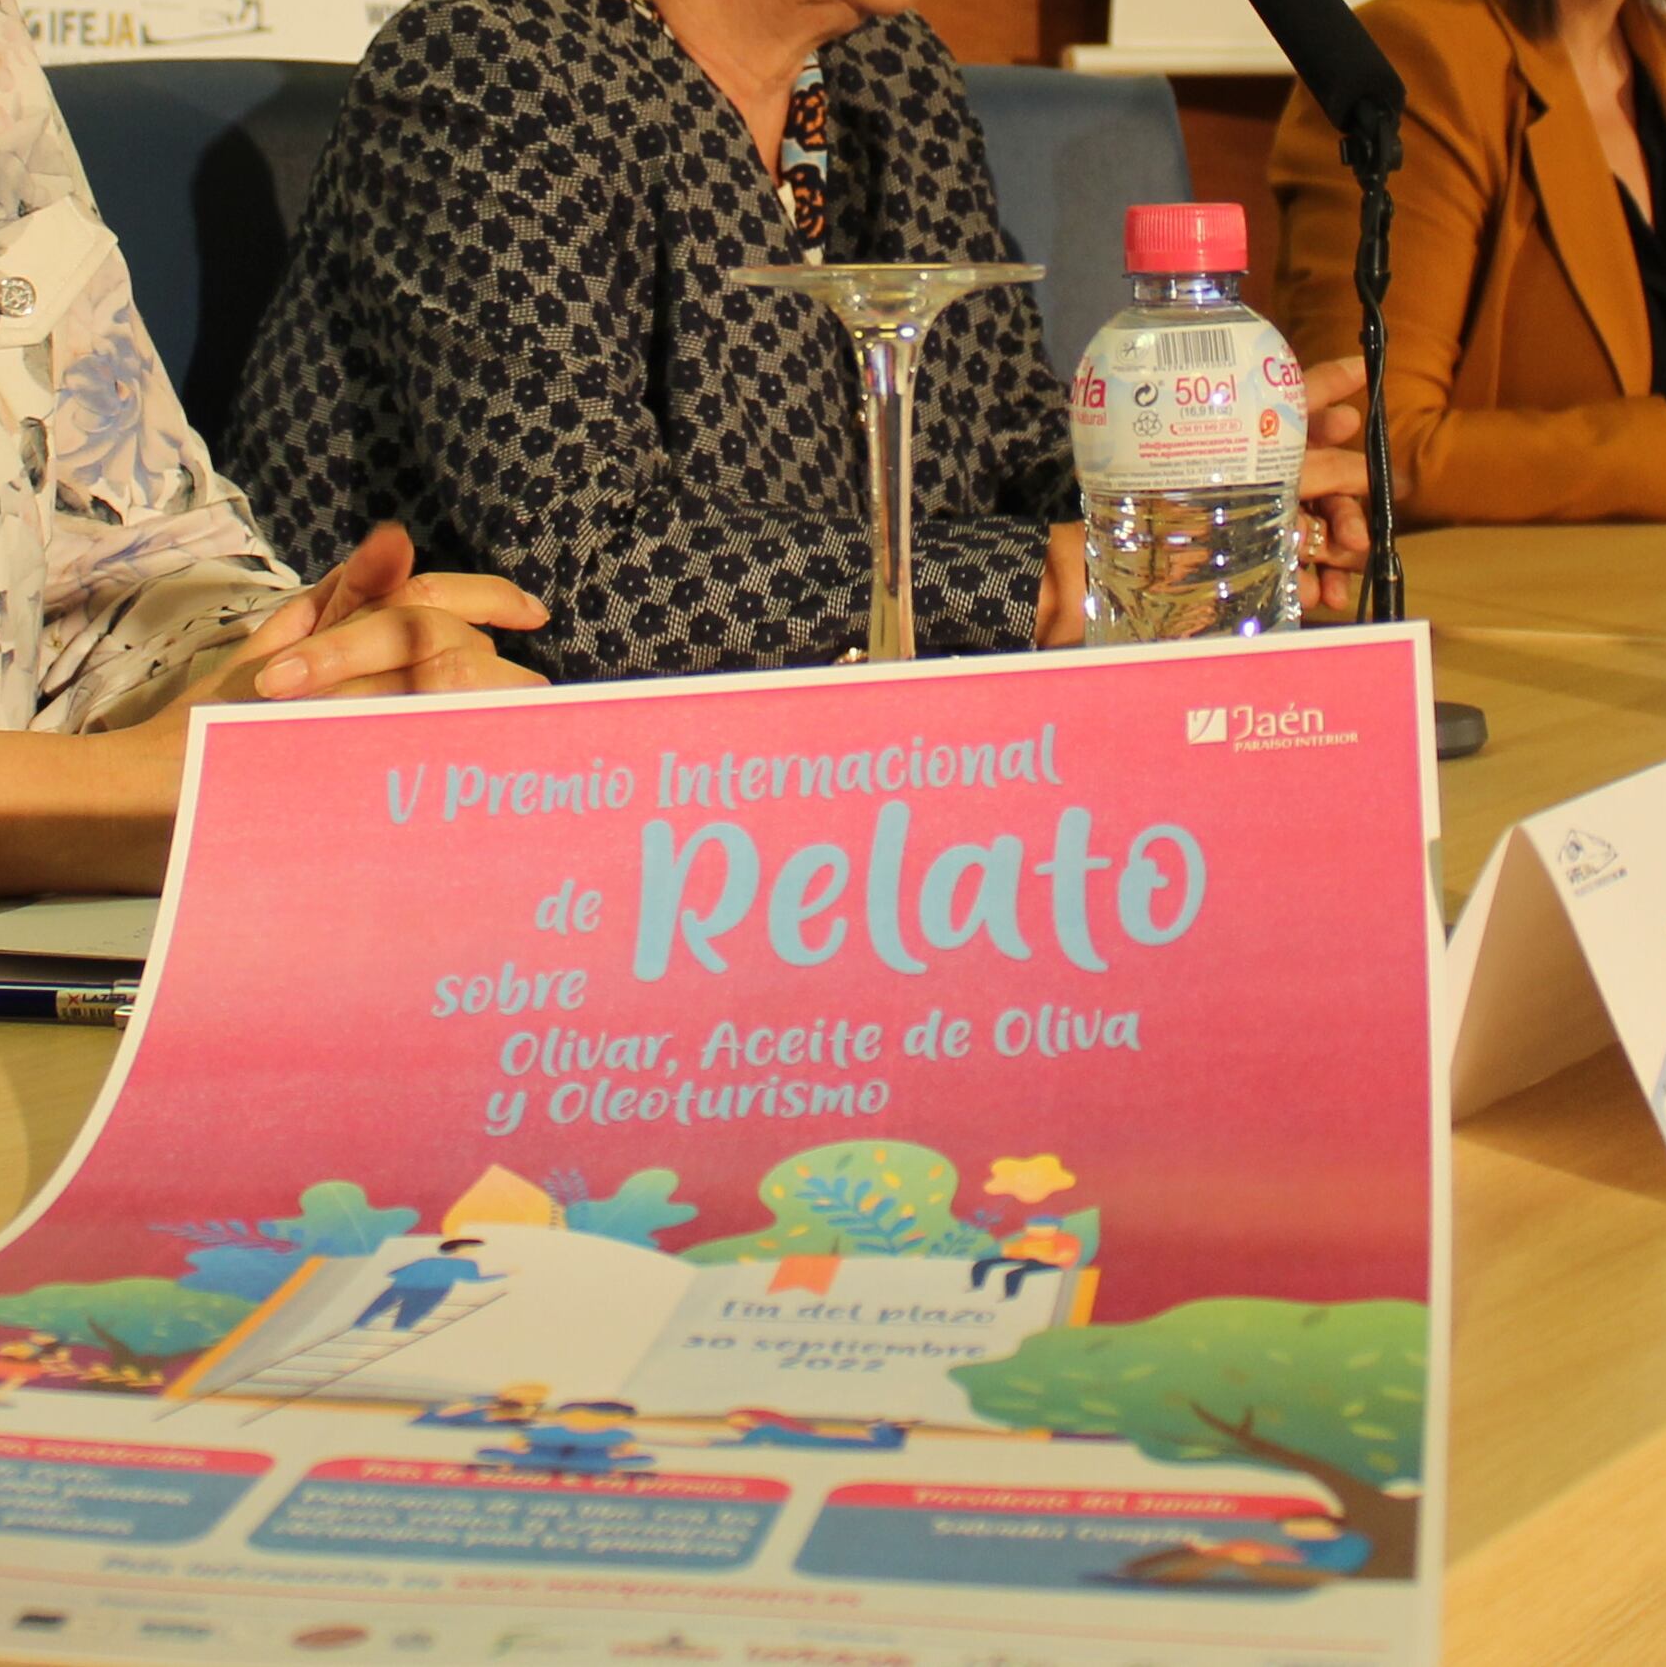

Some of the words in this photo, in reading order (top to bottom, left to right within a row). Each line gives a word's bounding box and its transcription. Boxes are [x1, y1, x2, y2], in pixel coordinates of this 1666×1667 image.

[48, 9, 137, 47] IFEJA
[1233, 702, 1326, 742] Jaén
[1294, 730, 1360, 749] INTERIOR
[386, 764, 428, 826] V
[440, 754, 637, 824] Premio
[656, 721, 1063, 812] Internacional
[532, 878, 603, 937] de
[628, 799, 1209, 983] Relato
[429, 963, 588, 1021] sobre
[499, 1029, 679, 1080] Olivar,
[699, 1018, 884, 1071] Aceite
[900, 1007, 974, 1060] de
[994, 1005, 1143, 1058] Oliva
[485, 1088, 528, 1138] y
[546, 1073, 892, 1127] Oleoturismo
[796, 1303, 864, 1323] del
[877, 1305, 997, 1326] plazo
[682, 1335, 737, 1350] 30
[752, 1336, 987, 1359] septiembre
[780, 1355, 886, 1373] 2022
